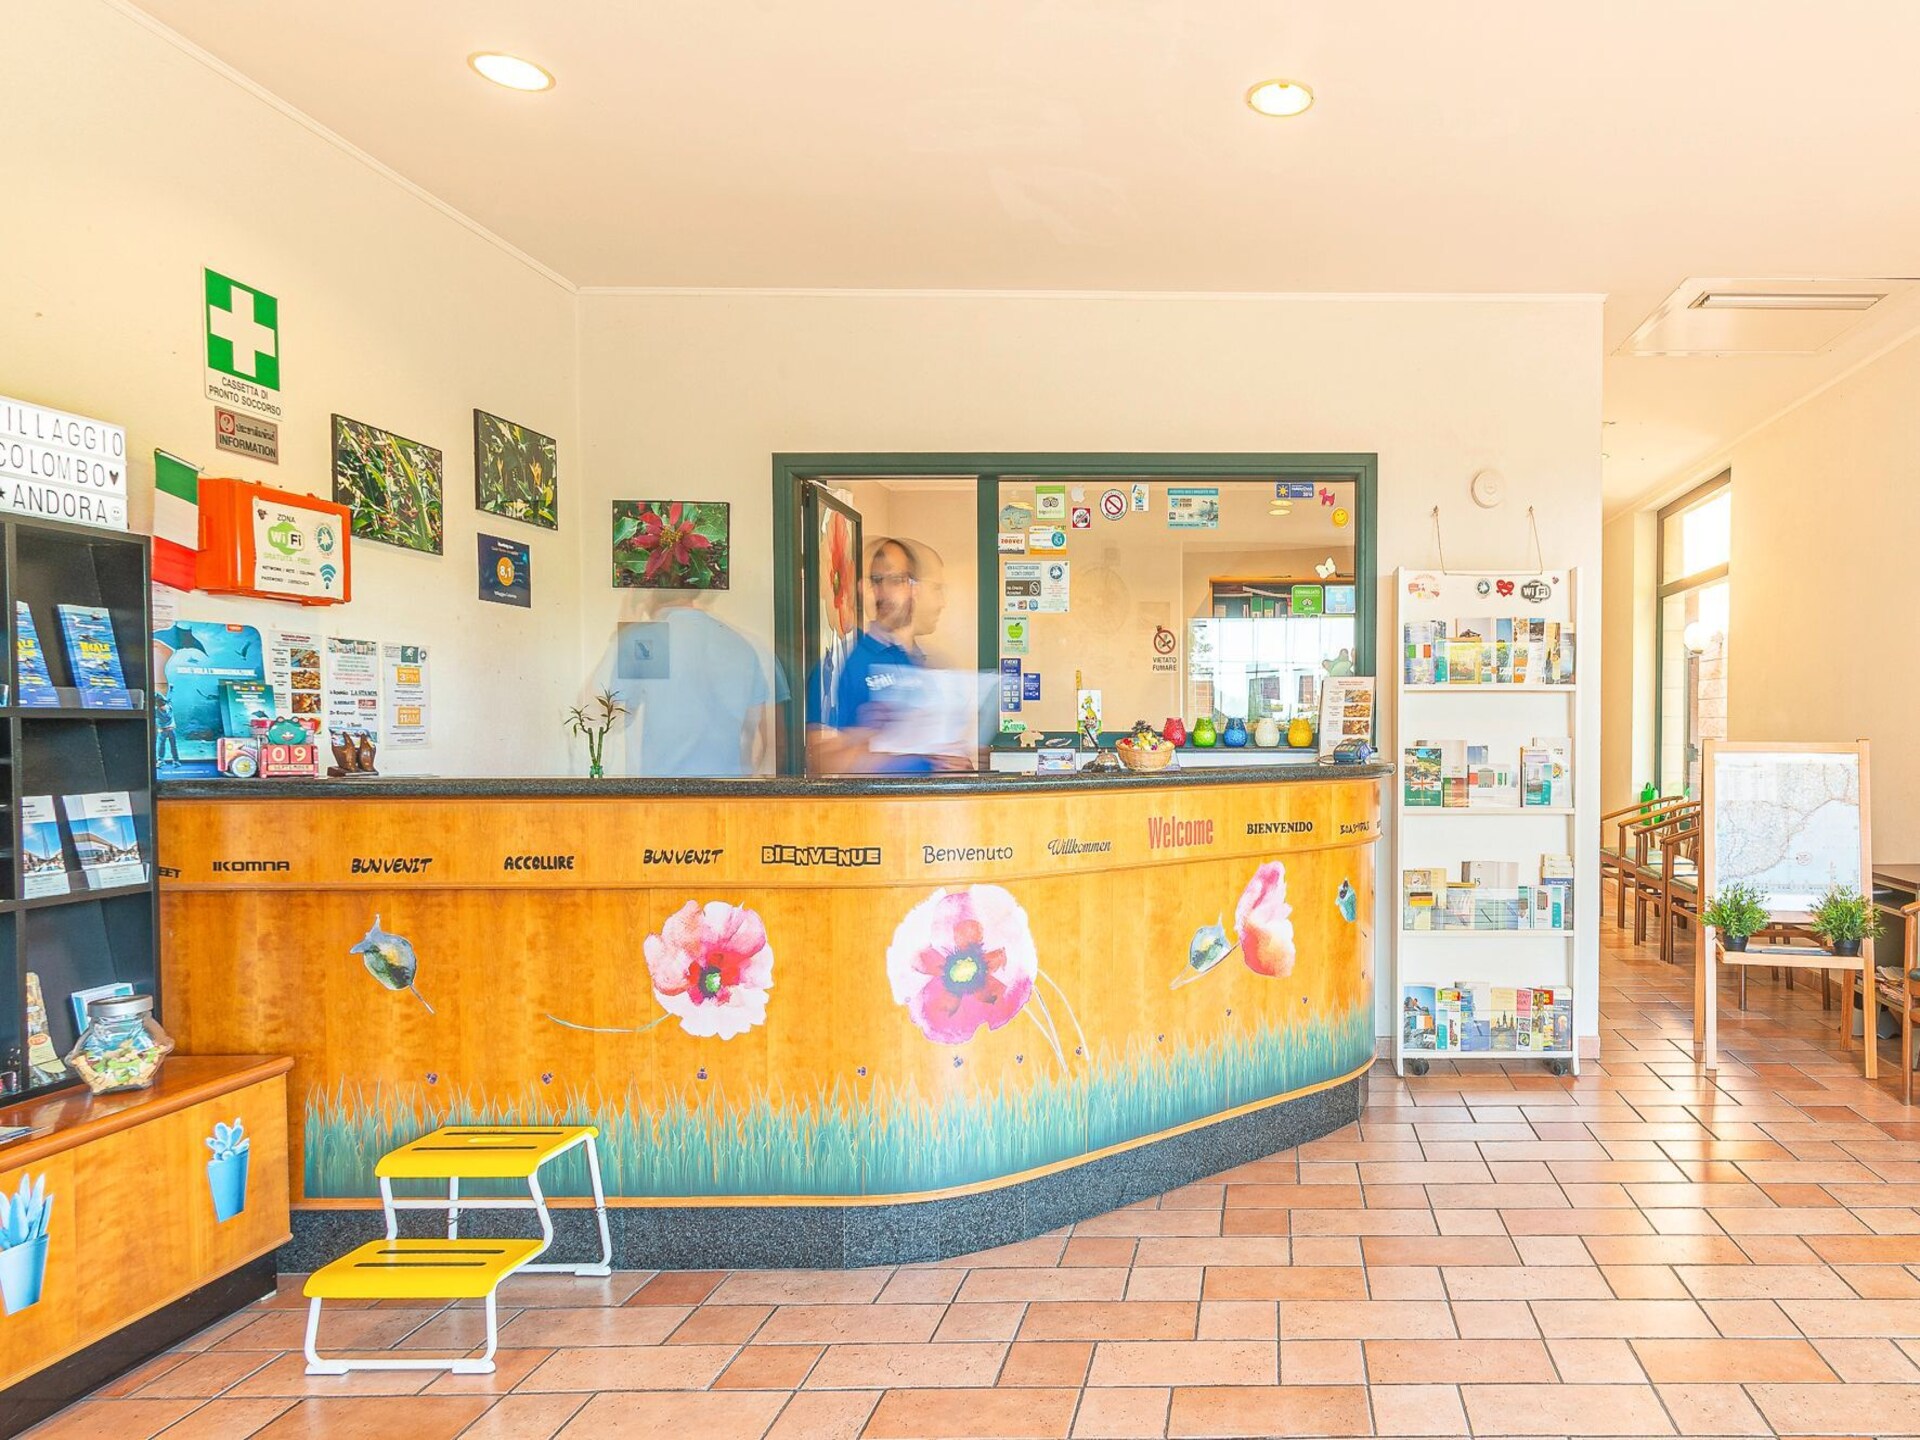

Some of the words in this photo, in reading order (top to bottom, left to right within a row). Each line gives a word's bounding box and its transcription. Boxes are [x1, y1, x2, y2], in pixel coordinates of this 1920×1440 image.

[222, 376, 259, 397] CASSETTA
[260, 389, 269, 400] DI
[208, 384, 239, 403] PRONTO
[241, 395, 282, 416] SOCCORSO
[7, 405, 123, 457] ILLAGGIO
[219, 434, 276, 458] INFORMATION
[12, 483, 108, 524] ANDORA
[276, 513, 296, 523] ZONA
[1152, 656, 1178, 664] VIETATO
[1148, 815, 1214, 849] Welcome
[1246, 821, 1313, 835] BIENVENIDO
[761, 844, 881, 866] BIENVENUE
[922, 844, 1014, 864] Benvenuto
[1047, 838, 1112, 856] Willkommen
[503, 855, 574, 870] ACCOLLIRE
